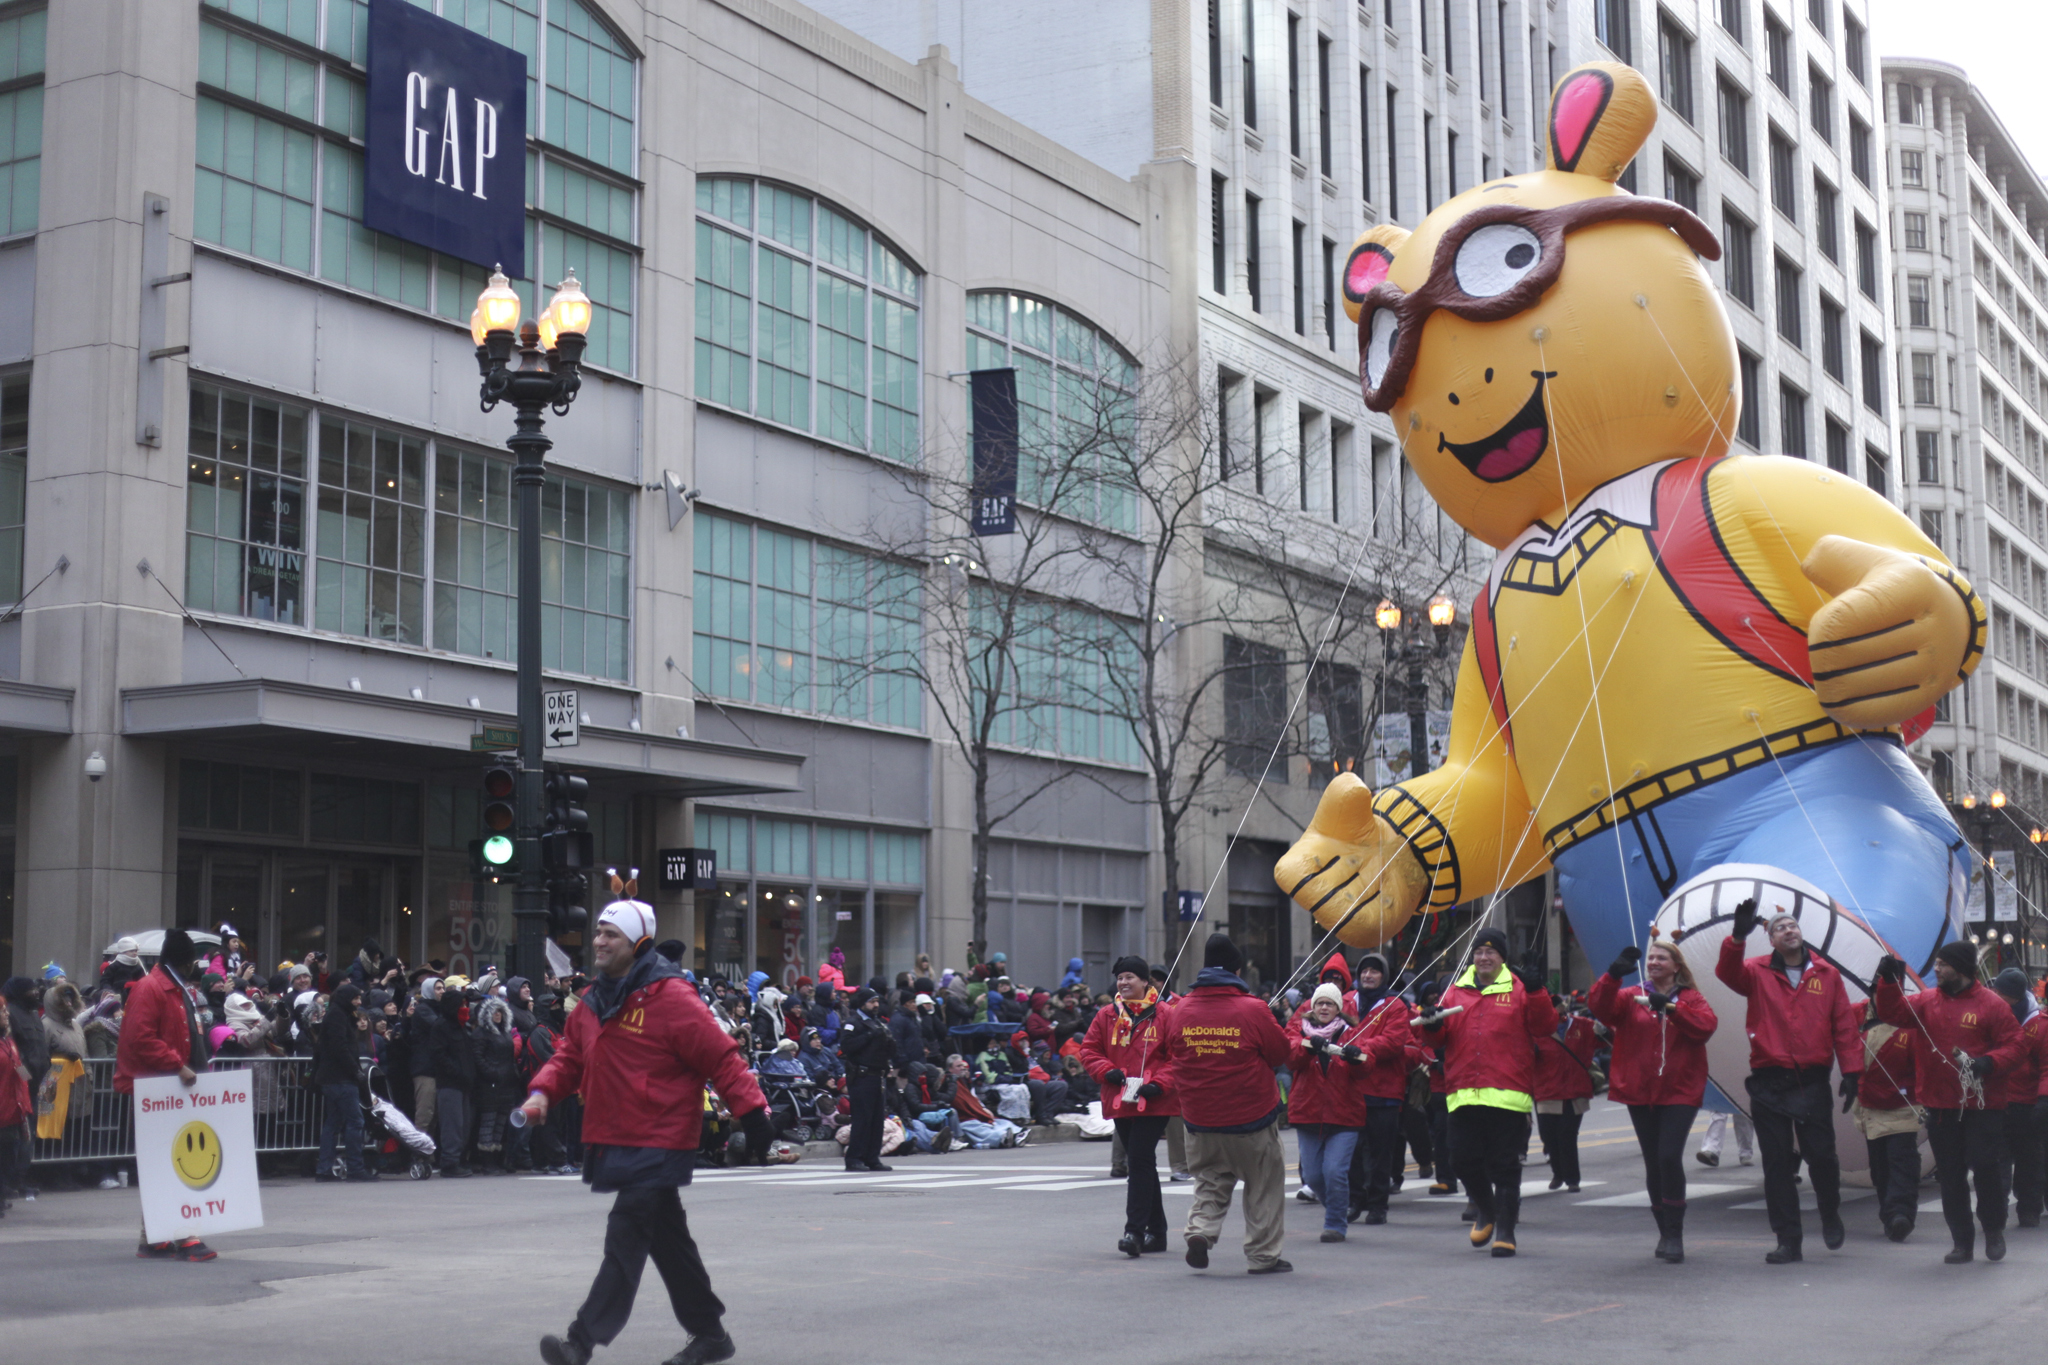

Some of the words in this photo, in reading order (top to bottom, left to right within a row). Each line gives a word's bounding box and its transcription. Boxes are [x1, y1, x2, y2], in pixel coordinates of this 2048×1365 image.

[404, 71, 498, 201] GAP
[271, 500, 291, 515] 100
[981, 497, 1008, 518] GAP
[256, 539, 301, 572] WIN
[547, 694, 574, 709] ONE
[547, 710, 575, 725] WAY
[667, 863, 686, 880] GAP
[697, 859, 713, 879] GAP
[449, 899, 479, 912] ENTIRE
[1182, 1026, 1240, 1036] McDonald's
[1183, 1037, 1239, 1048] Thanksgiving
[1195, 1046, 1226, 1057] Parade
[141, 1095, 184, 1113] Smile
[189, 1093, 216, 1108] You
[221, 1090, 247, 1105] Are
[181, 1204, 202, 1219] On
[205, 1200, 226, 1216] TV
